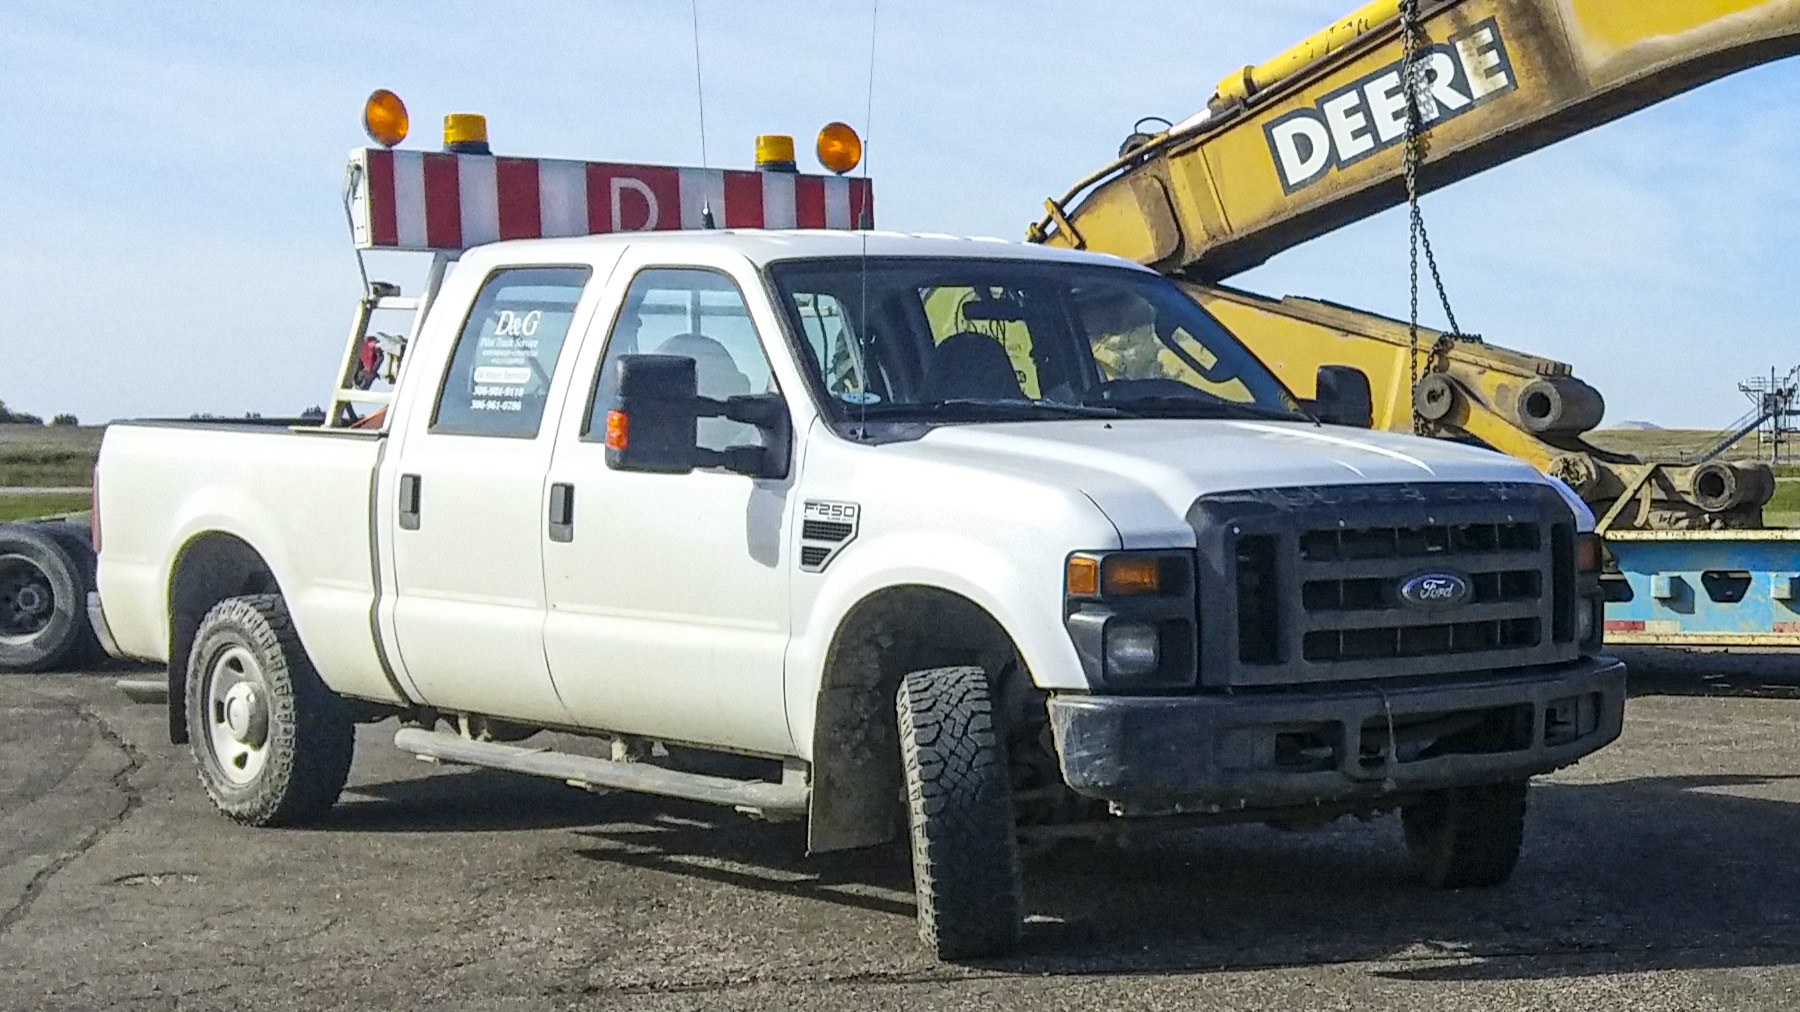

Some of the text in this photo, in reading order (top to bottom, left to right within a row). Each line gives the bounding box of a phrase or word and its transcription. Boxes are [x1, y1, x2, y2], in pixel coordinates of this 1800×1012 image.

[1271, 27, 1509, 186] DEERE
[610, 176, 659, 233] D
[494, 310, 542, 336] D&G
[1420, 579, 1454, 599] Ford
